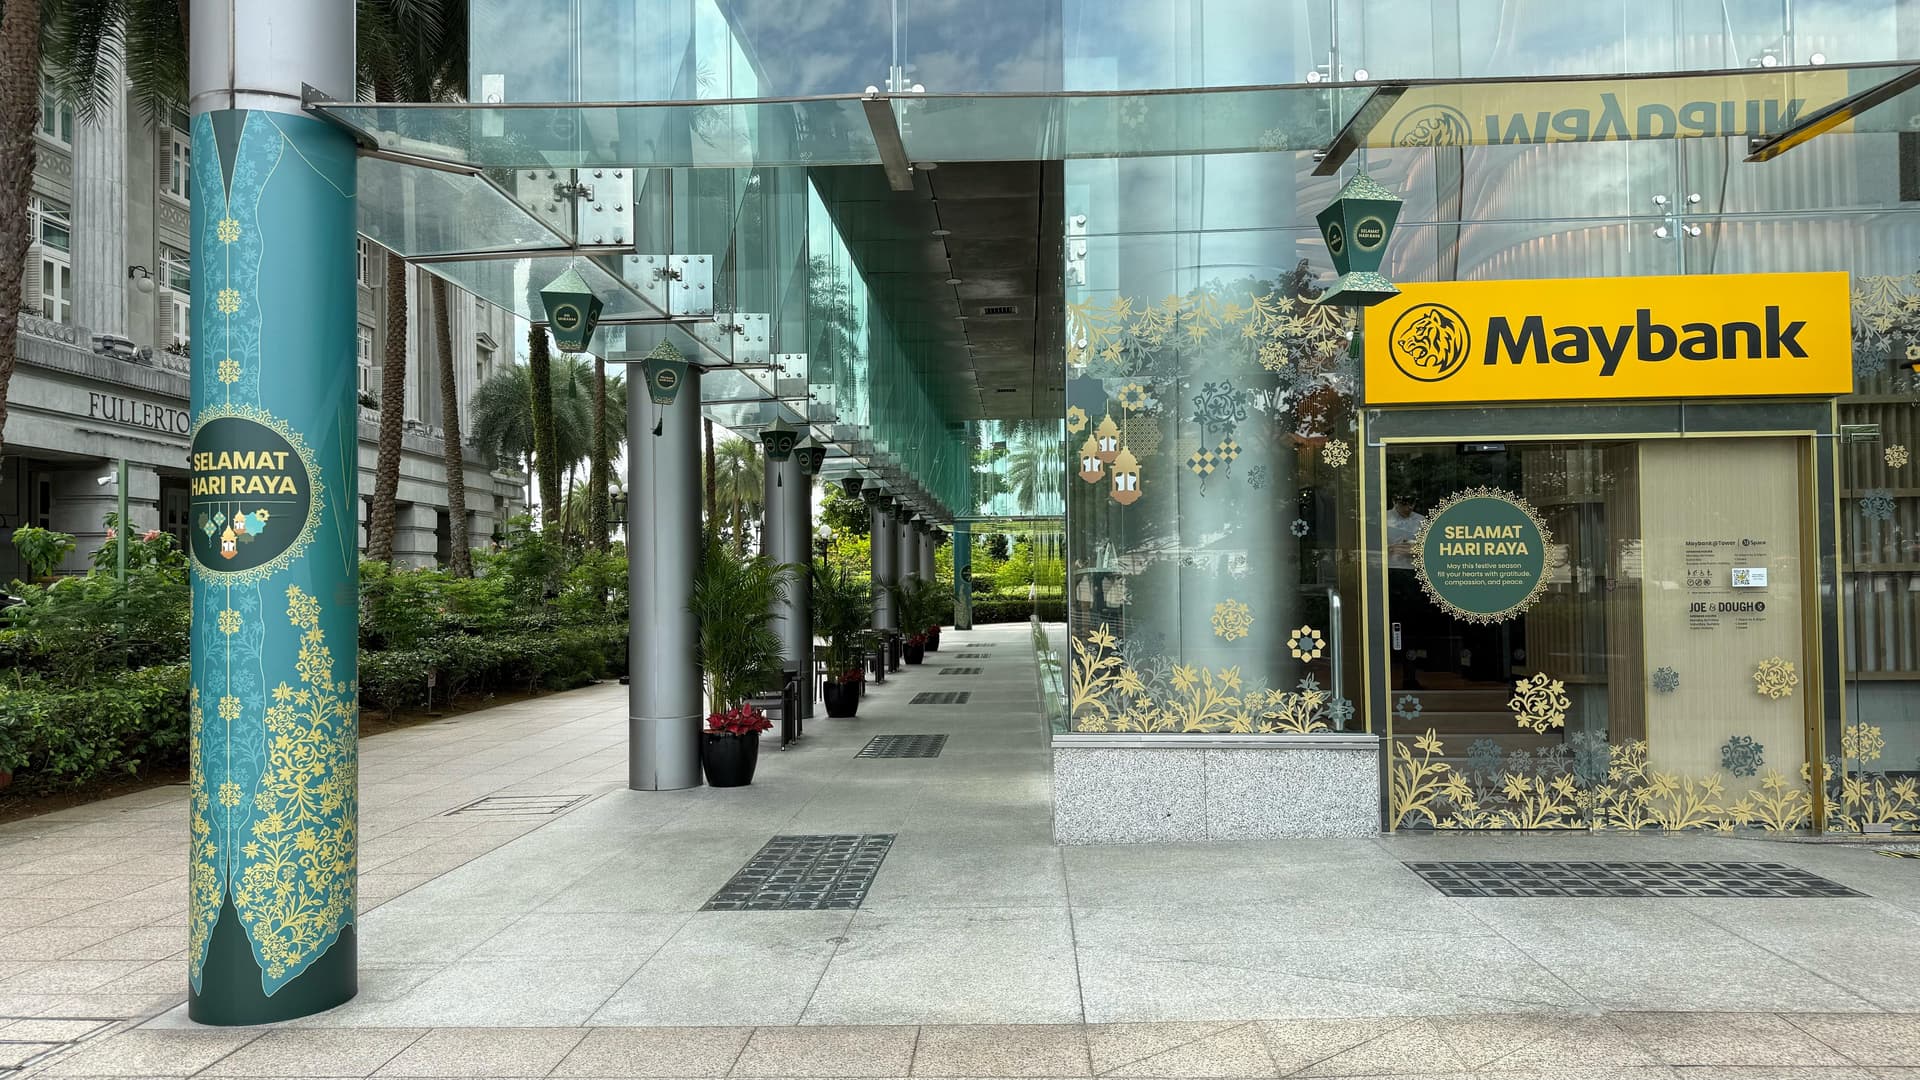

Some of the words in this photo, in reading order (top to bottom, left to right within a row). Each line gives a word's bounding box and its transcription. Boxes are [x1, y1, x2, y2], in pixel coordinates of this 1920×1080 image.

[1483, 305, 1809, 376] Maybank
[193, 450, 290, 472] SELAMAT
[191, 475, 226, 497] HARI
[231, 475, 298, 495] RAYA
[1444, 525, 1523, 539] SELAMAT
[1439, 542, 1480, 556] HARI
[1485, 542, 1529, 556] RAYA
[1689, 602, 1707, 612] JOE
[1709, 602, 1716, 612] &
[1718, 602, 1754, 612] DOUGH
